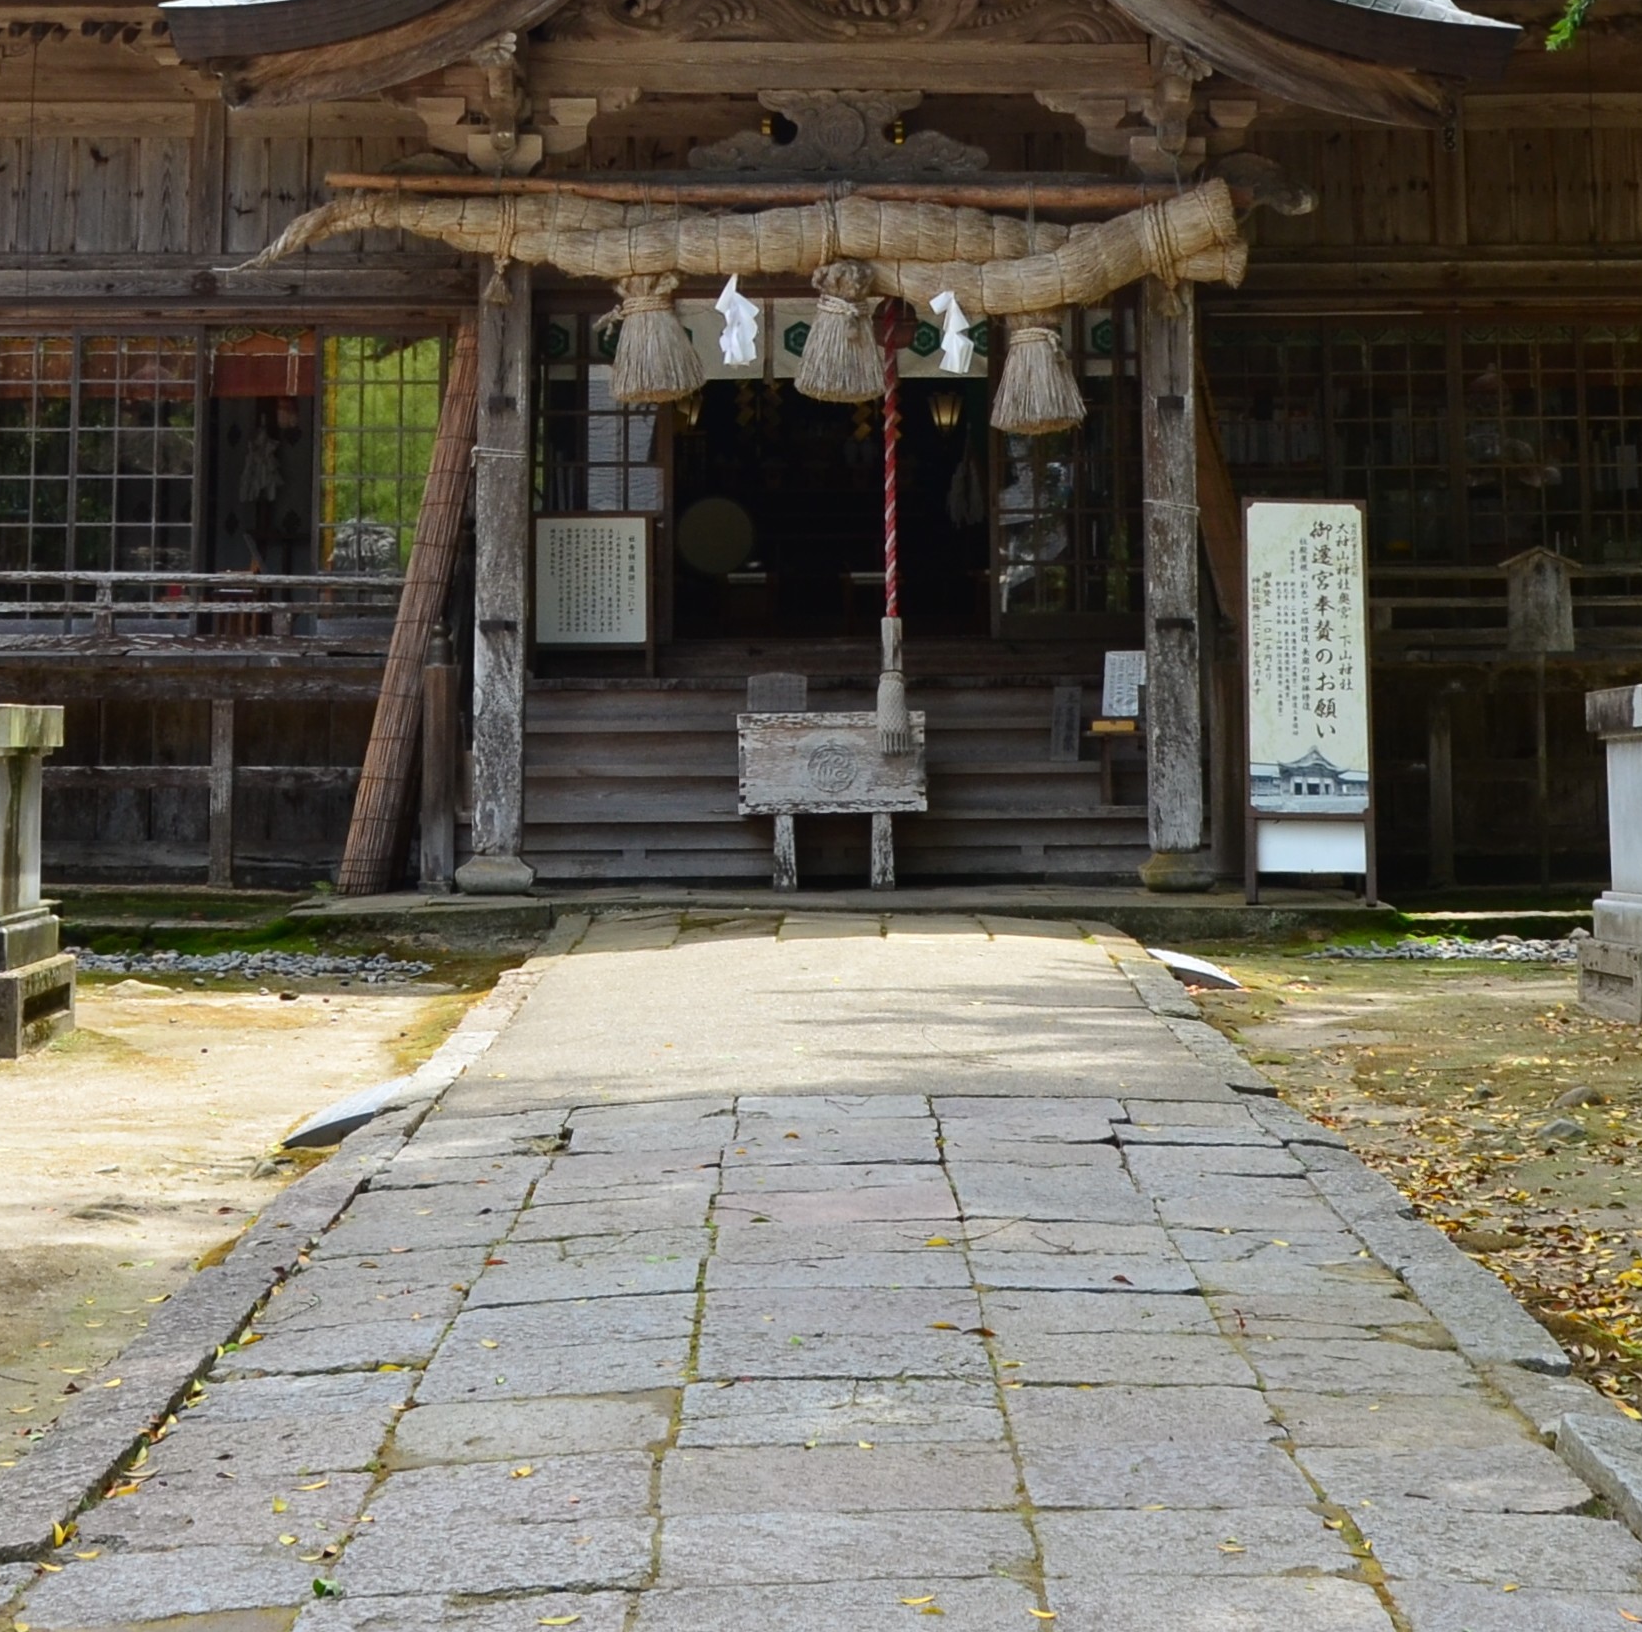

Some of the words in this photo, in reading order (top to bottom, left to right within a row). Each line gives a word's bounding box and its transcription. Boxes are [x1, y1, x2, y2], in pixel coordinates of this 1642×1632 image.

[1309, 520, 1337, 738] 御遷宮奉賛のお願い
[1336, 522, 1354, 691] 大神山神社奥宮・下山神社
